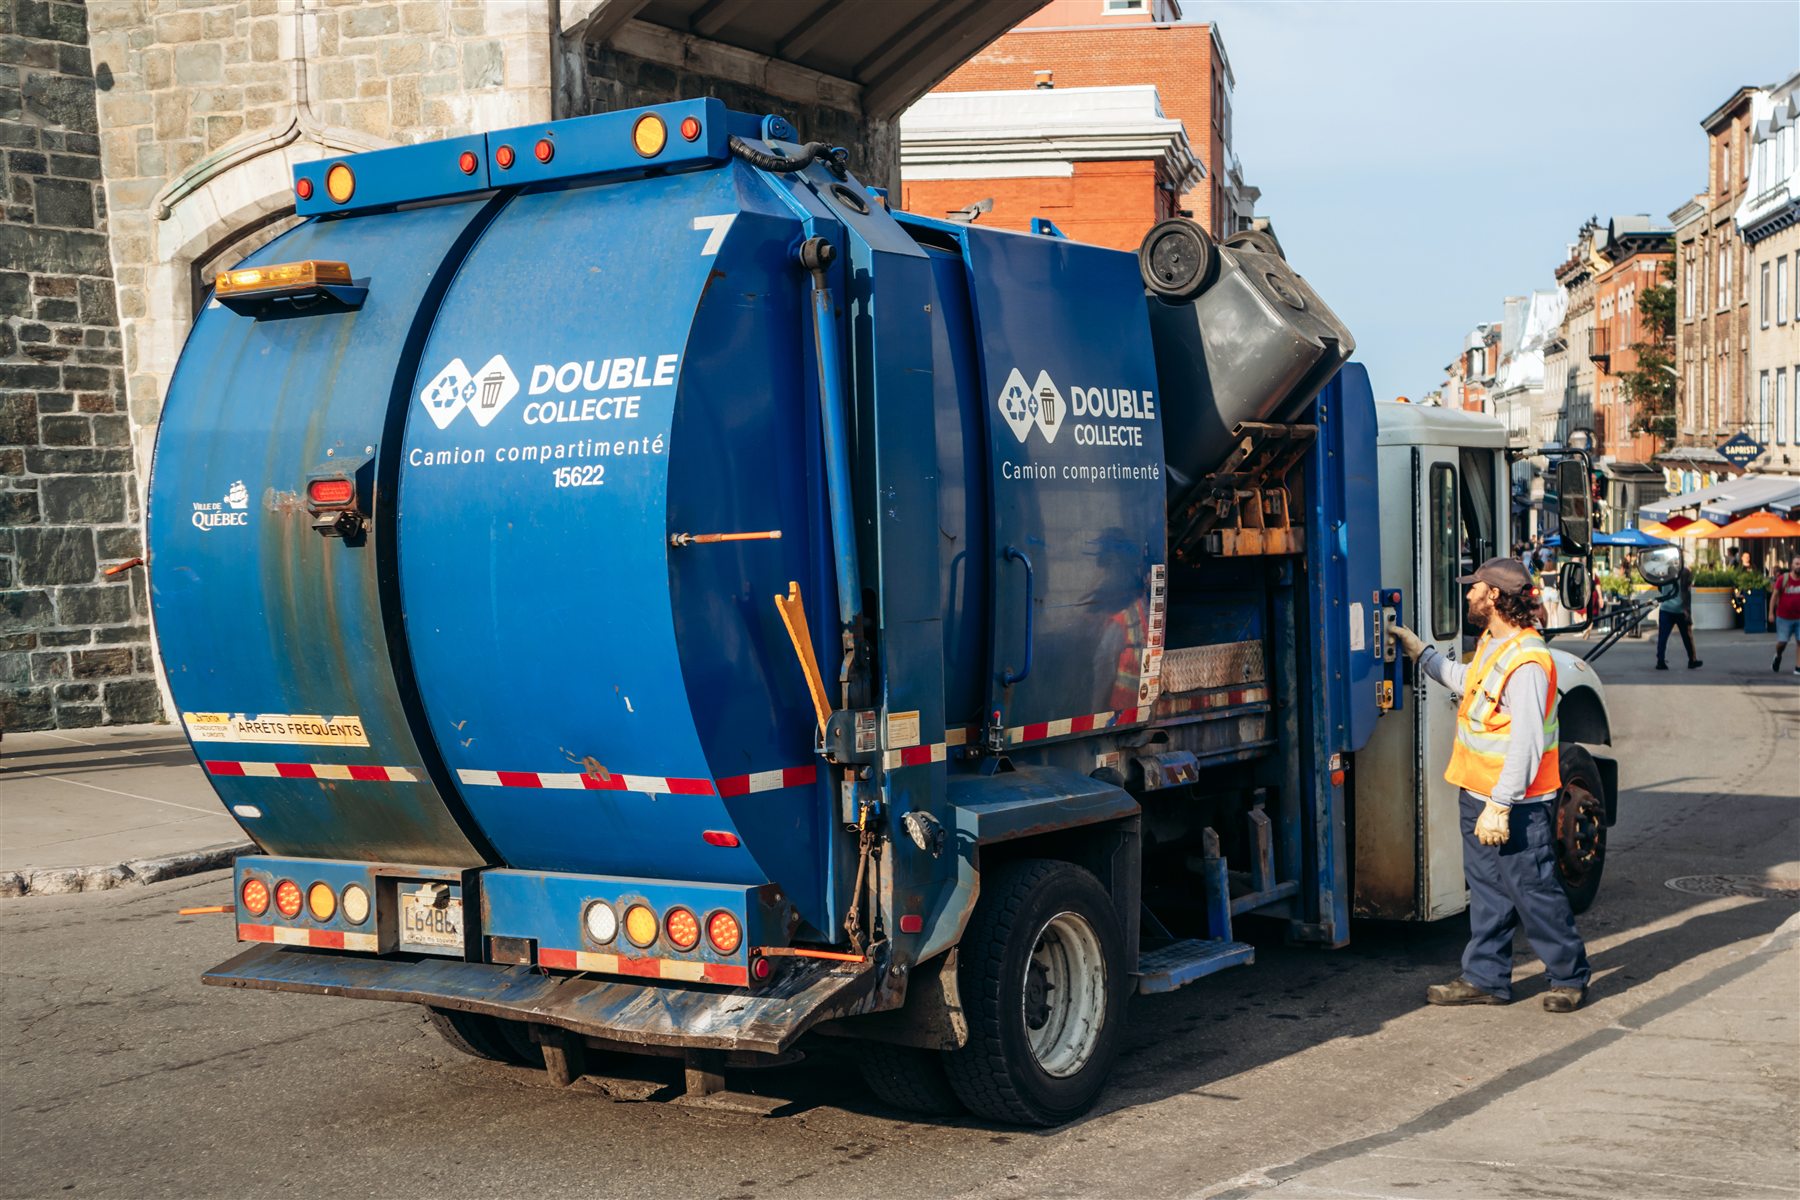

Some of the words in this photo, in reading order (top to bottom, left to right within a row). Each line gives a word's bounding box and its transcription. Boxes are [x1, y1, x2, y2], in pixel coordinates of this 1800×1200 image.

[693, 213, 738, 256] 7
[528, 354, 679, 395] DOUBLE
[523, 396, 641, 425] COLLECTE
[1070, 386, 1155, 419] DOUBLE
[1074, 424, 1143, 446] COLLECTE
[409, 447, 485, 466] Camion
[495, 433, 664, 464] compartimenté
[552, 464, 605, 488] 15622
[1002, 461, 1056, 480] Camion
[1062, 463, 1160, 483] compartimenté
[192, 502, 212, 511] VILLE
[212, 502, 222, 510] DE
[191, 510, 248, 531] QUÉBEC
[238, 720, 286, 734] ARRÊTS
[288, 721, 362, 737] FRÉQUENTS
